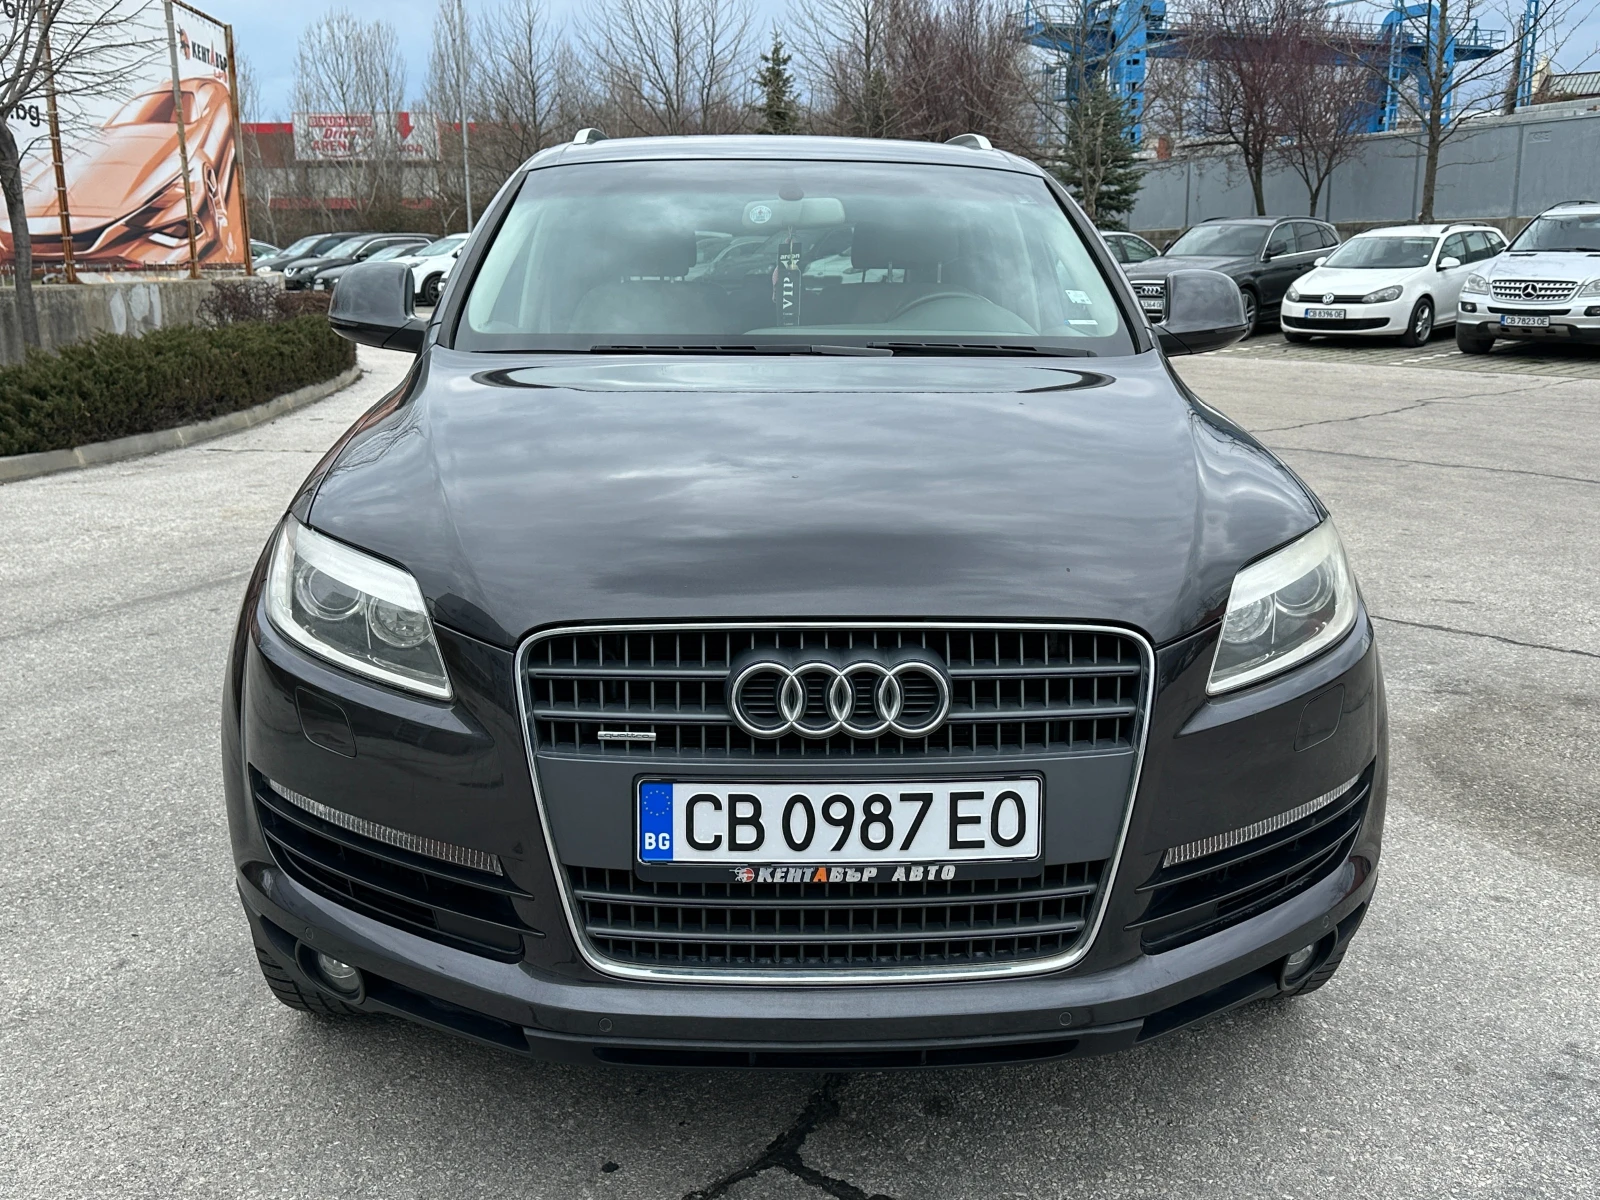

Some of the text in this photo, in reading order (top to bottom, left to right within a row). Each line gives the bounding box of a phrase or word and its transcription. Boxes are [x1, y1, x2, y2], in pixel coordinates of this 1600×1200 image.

[783, 277, 793, 309] VIP
[1506, 316, 1516, 324] CB
[1517, 317, 1536, 325] 7823
[685, 793, 766, 852] CB
[781, 793, 934, 852] 0987
[644, 832, 670, 850] BG
[756, 865, 956, 884] КЕНТАВЪР АВТО
